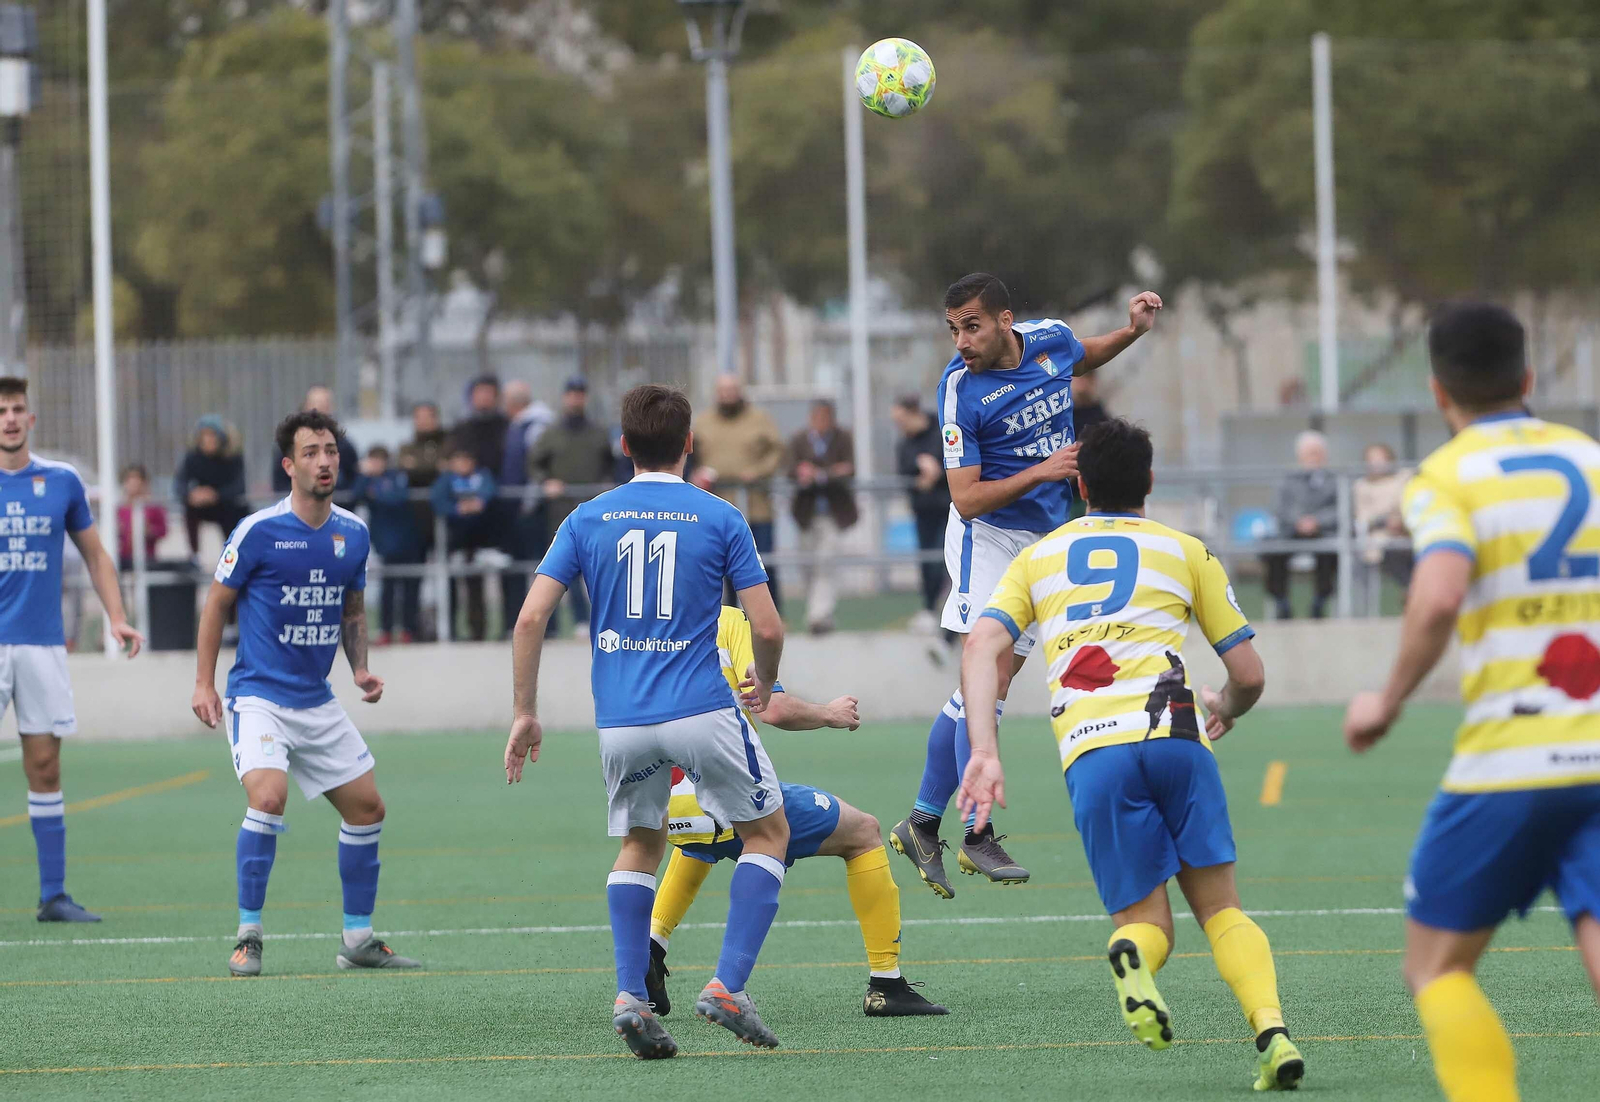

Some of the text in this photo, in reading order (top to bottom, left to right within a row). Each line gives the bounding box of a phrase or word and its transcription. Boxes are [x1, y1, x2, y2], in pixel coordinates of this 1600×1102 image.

[981, 383, 1016, 405] macron
[1002, 386, 1071, 435] XEREZ
[6, 501, 25, 516] EL
[612, 511, 655, 520] CAPILAR
[657, 511, 699, 523] ERCILLA
[1498, 454, 1600, 581] 2
[0, 515, 52, 536] EREZ
[8, 536, 27, 551] DE
[275, 541, 308, 550] macron
[0, 551, 47, 572] EREZ
[309, 569, 326, 583] EL
[617, 529, 677, 620] 11
[1066, 535, 1140, 621] 9
[306, 609, 323, 623] DE
[279, 624, 340, 645] JEREZ
[668, 822, 692, 831] ppa
